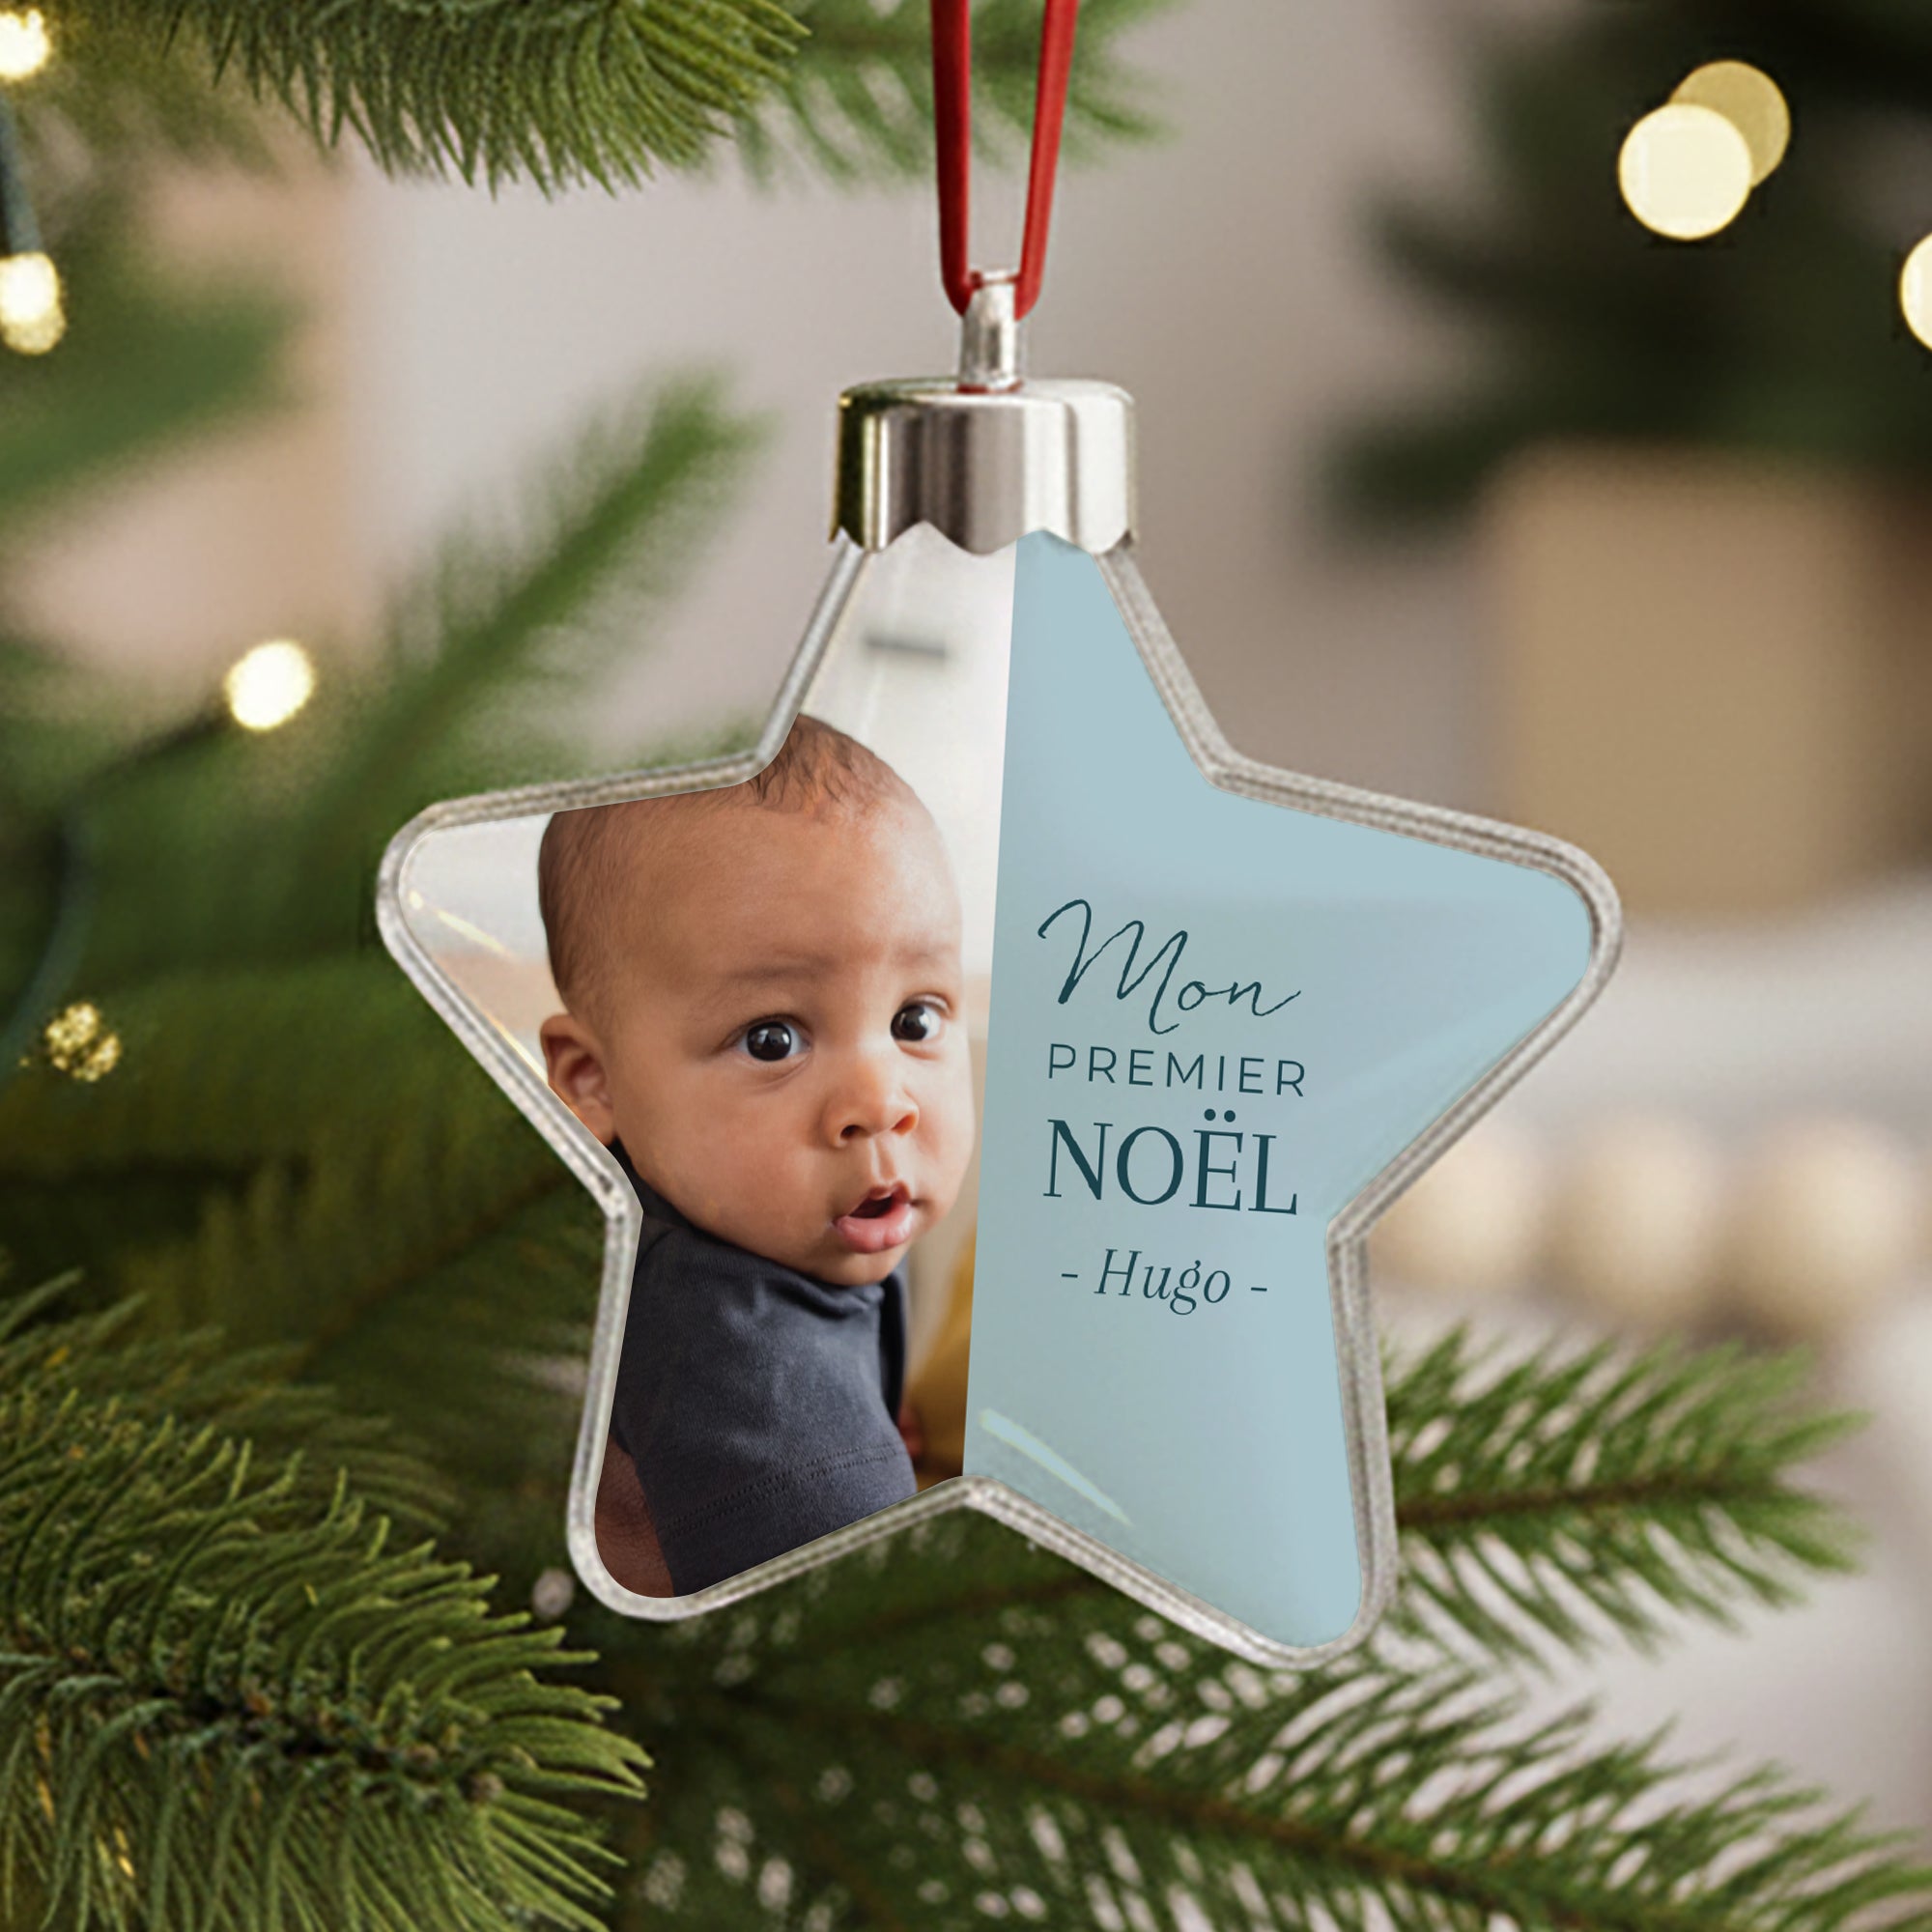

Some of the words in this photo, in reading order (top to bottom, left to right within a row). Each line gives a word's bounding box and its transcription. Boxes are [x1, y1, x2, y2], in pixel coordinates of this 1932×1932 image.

[1037, 897, 1302, 1036] Mon
[1047, 1042, 1306, 1098] PREMIER
[1042, 1108, 1298, 1216] NOËL
[1093, 1247, 1233, 1317] Hugo
